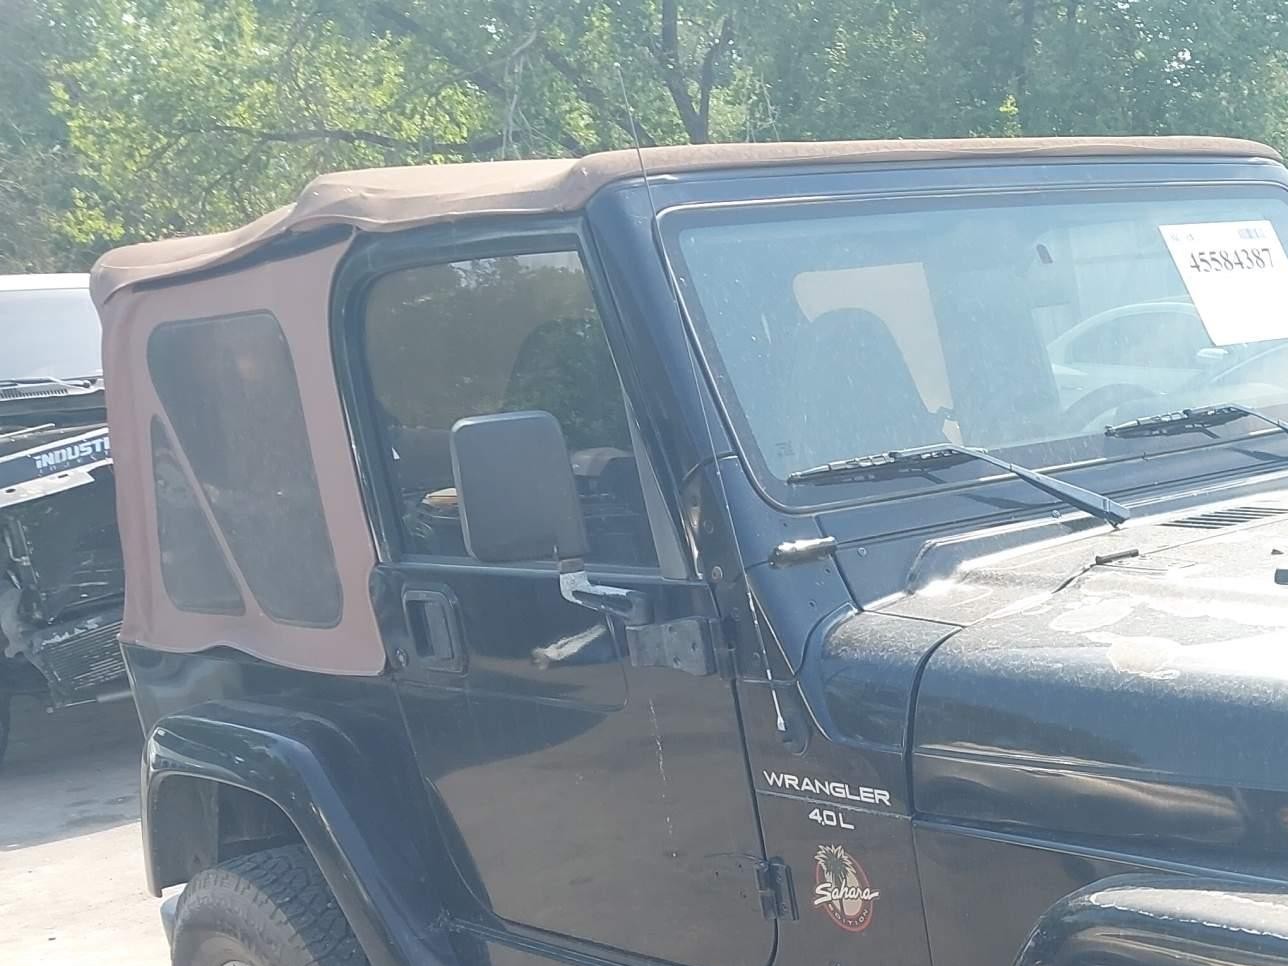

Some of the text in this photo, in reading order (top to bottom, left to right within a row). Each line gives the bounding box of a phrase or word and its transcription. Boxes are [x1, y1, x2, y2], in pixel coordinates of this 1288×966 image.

[1189, 248, 1274, 273] 45584387
[763, 770, 891, 806] WRANGLER
[814, 879, 880, 905] Sahara
